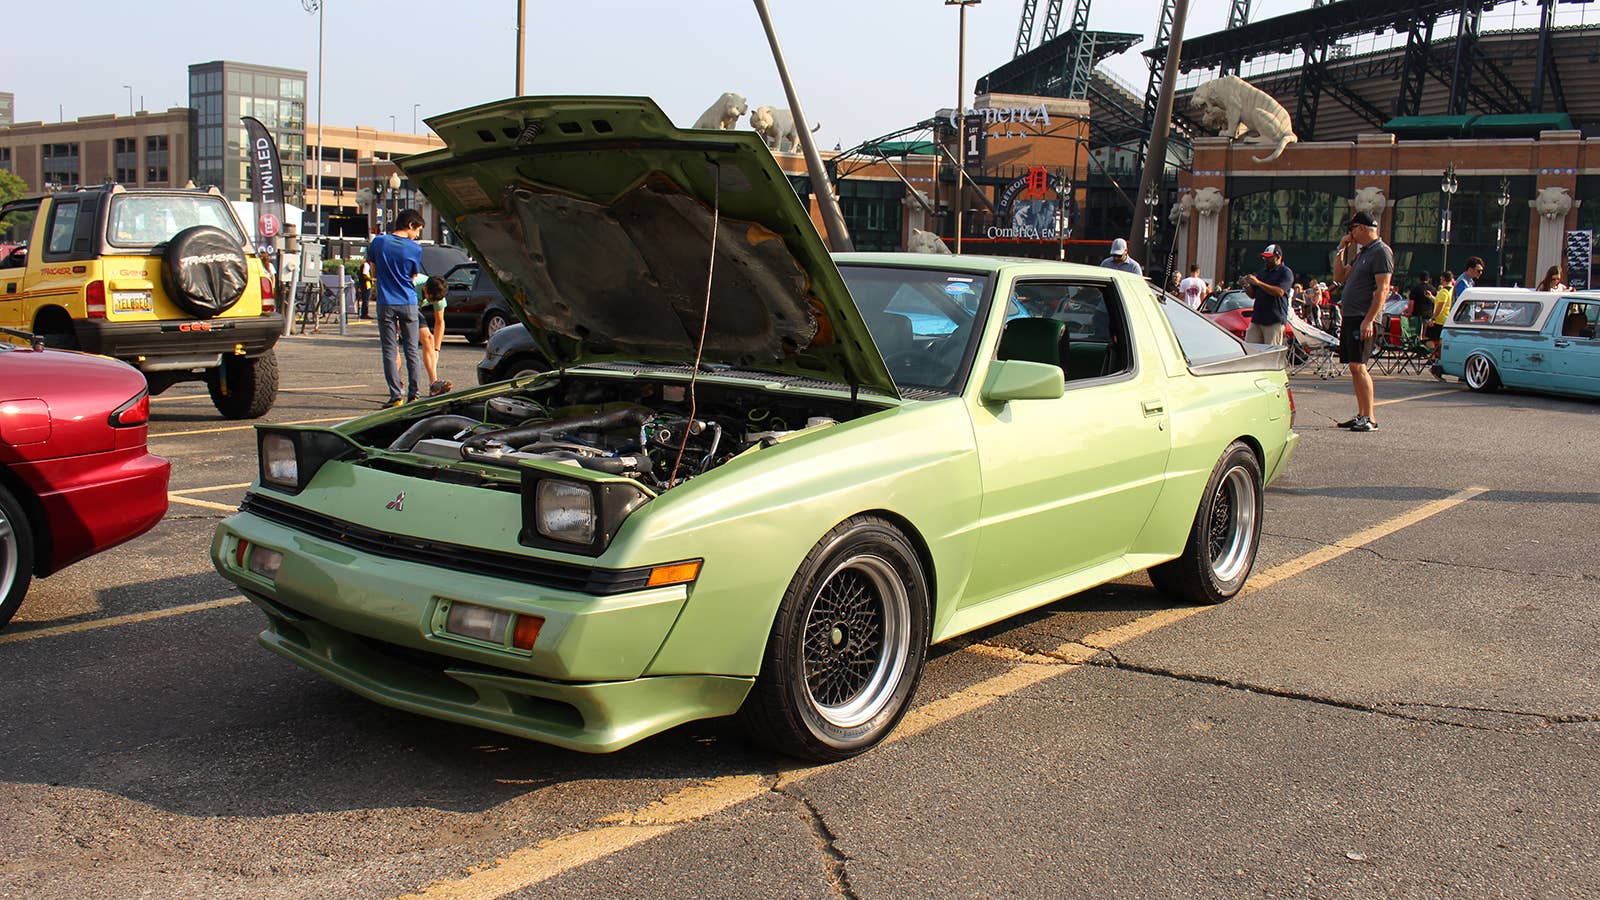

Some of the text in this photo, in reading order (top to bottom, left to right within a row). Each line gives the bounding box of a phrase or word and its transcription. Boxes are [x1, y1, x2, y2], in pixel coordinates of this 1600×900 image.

[968, 134, 979, 156] 1
[1001, 177, 1027, 207] DETROIT
[1042, 228, 1073, 239] ENY
[40, 266, 73, 276] TRACKER
